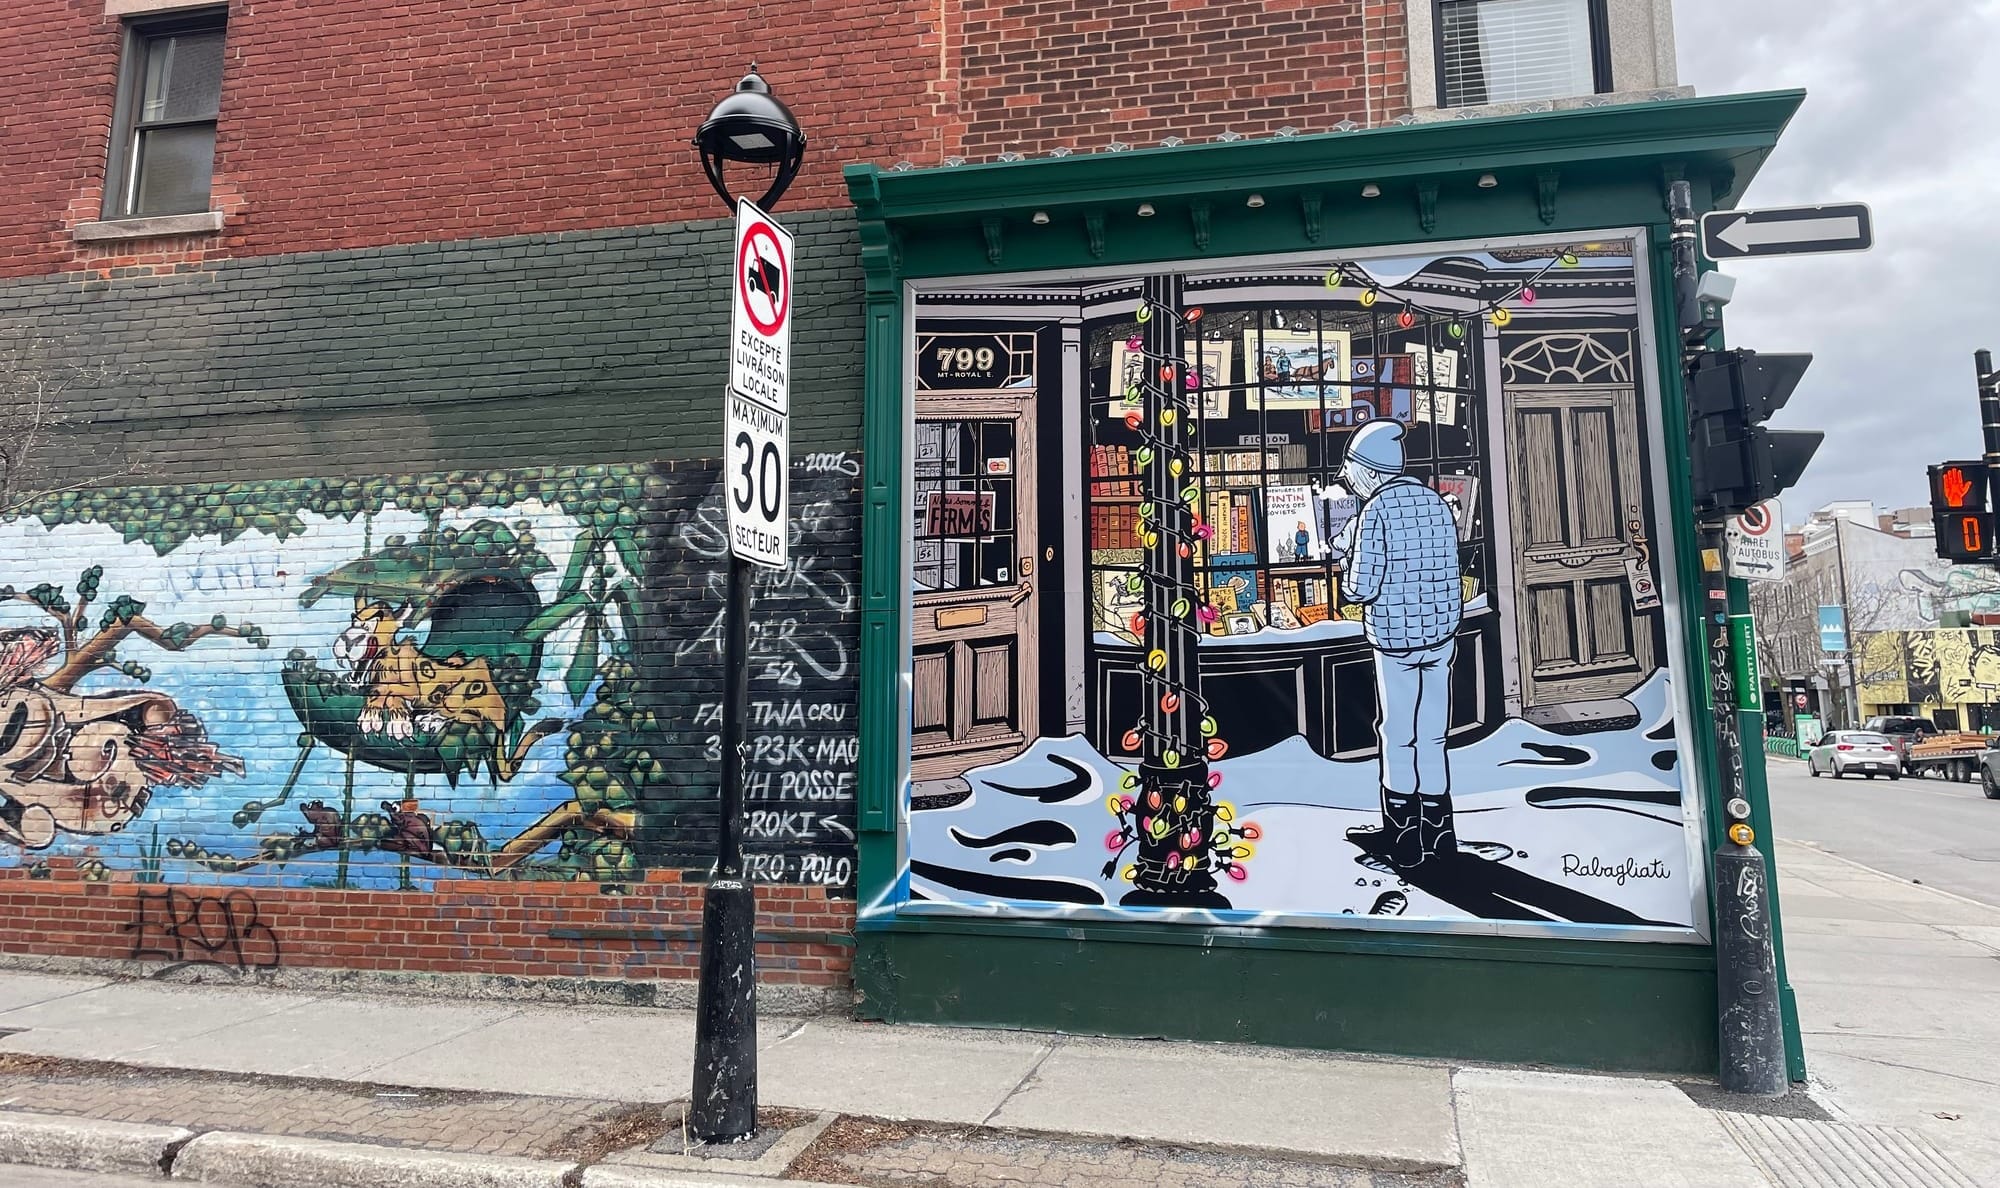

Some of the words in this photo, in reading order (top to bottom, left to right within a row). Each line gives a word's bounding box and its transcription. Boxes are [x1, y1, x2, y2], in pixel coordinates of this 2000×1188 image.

[741, 329, 782, 365] EXCEPTÉ
[936, 347, 995, 371] 799
[737, 348, 785, 387] LIVRAISON
[937, 371, 982, 379] MT-ROYAL
[986, 371, 995, 379] E.
[742, 372, 778, 404] LOCALE
[732, 400, 783, 437] MAXIMUM
[1243, 435, 1287, 444] FICION
[733, 431, 782, 523] 30
[1267, 494, 1305, 503] TINTIN
[735, 524, 780, 556] SECTEUR
[1962, 517, 1981, 551] 0
[1744, 624, 1753, 655] VERT
[1747, 657, 1756, 691] PARTI
[751, 699, 807, 728] TWA
[807, 703, 846, 722] CRU
[780, 769, 858, 801] POSSE
[800, 853, 851, 886] POLO
[1560, 853, 1671, 886] Rabagliati
